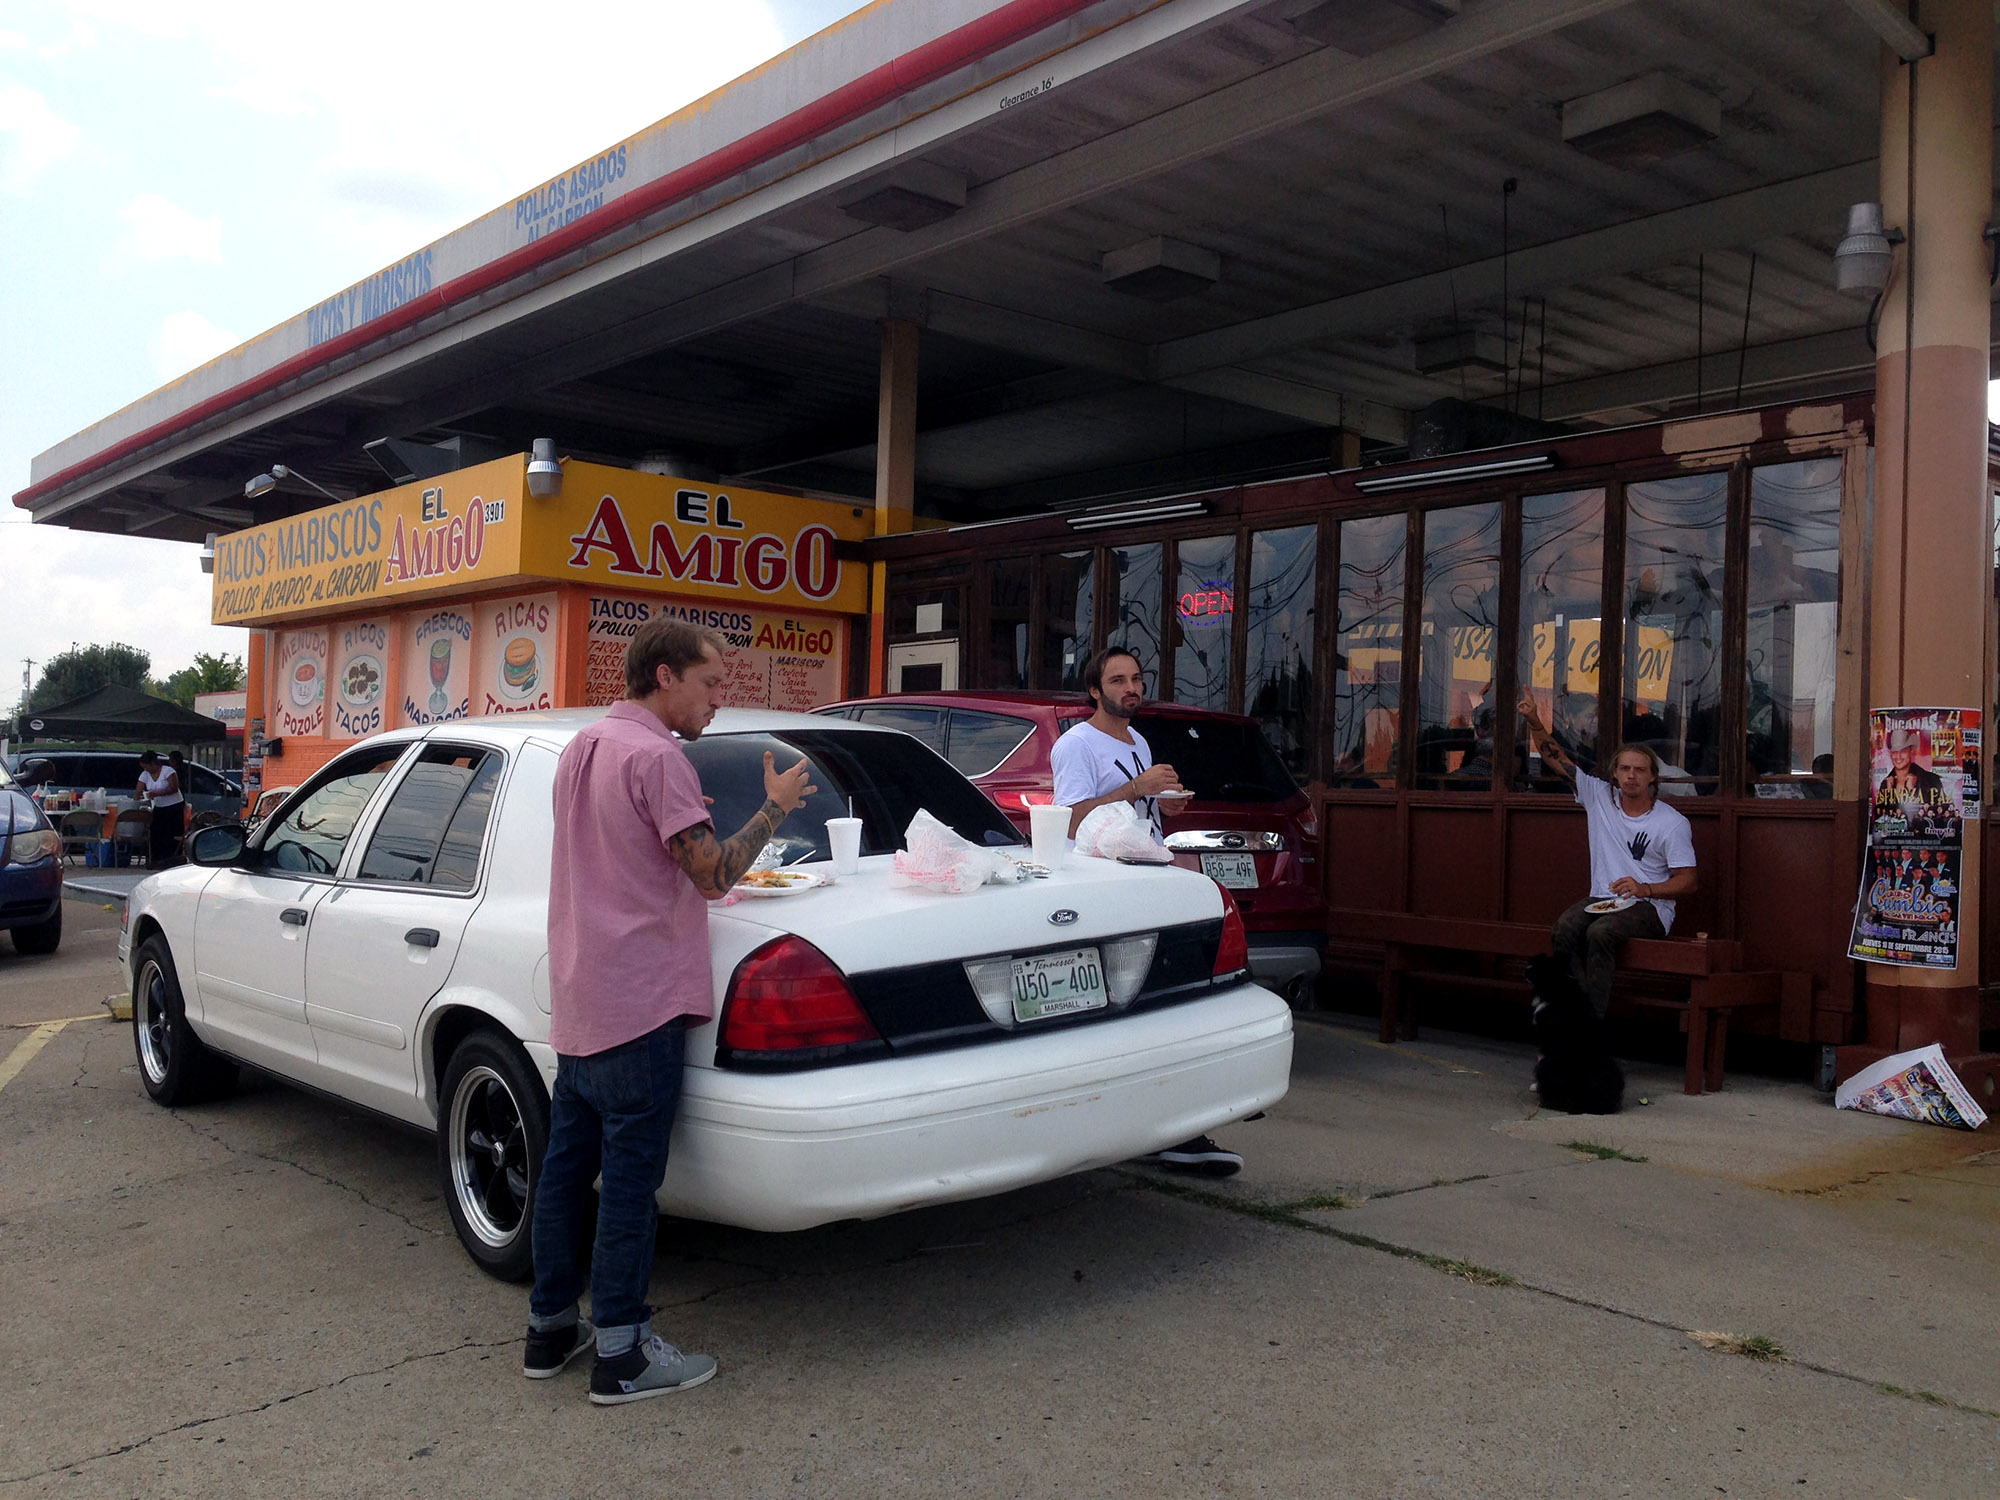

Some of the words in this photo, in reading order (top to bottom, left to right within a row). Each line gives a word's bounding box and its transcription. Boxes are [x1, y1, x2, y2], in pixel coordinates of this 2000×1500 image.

[1000, 86, 1039, 109] Clearance
[1042, 76, 1054, 91] 16'
[516, 178, 565, 230] POLLOS
[569, 145, 626, 203] ASADOS
[307, 294, 344, 348] TACOS
[362, 248, 431, 325] MARISCOS
[422, 488, 448, 522] EL
[677, 491, 744, 529] EL
[217, 532, 266, 584] TACOS
[277, 500, 383, 572] MARISCOS
[384, 497, 484, 583] AMIGO
[485, 501, 504, 522] 3901
[569, 496, 839, 598] AMIGO
[219, 584, 261, 617] POLLOS
[261, 574, 313, 610] ASADOS
[311, 579, 325, 601] AL
[326, 560, 383, 599] CARBON
[1180, 590, 1234, 616] OPEN
[416, 611, 472, 646] FRESCOS
[495, 601, 550, 638] RICAS
[590, 598, 650, 622] TACOS
[662, 605, 752, 632] MARISCOS
[597, 620, 643, 637] POLLO
[784, 619, 806, 632] EL
[282, 630, 326, 669] MENUDO
[344, 623, 386, 652] RICOS
[589, 640, 627, 655] TACOS
[755, 623, 834, 655] AMIGO
[776, 655, 825, 669] MARISCOS
[283, 705, 323, 736] POZOLE
[335, 702, 380, 735] TACOS
[1932, 740, 1955, 757] 12
[1056, 911, 1073, 922] Ford
[1013, 963, 1024, 975] FEB
[1033, 958, 1076, 972] Tennessee
[1044, 1000, 1081, 1012] MARSHALL
